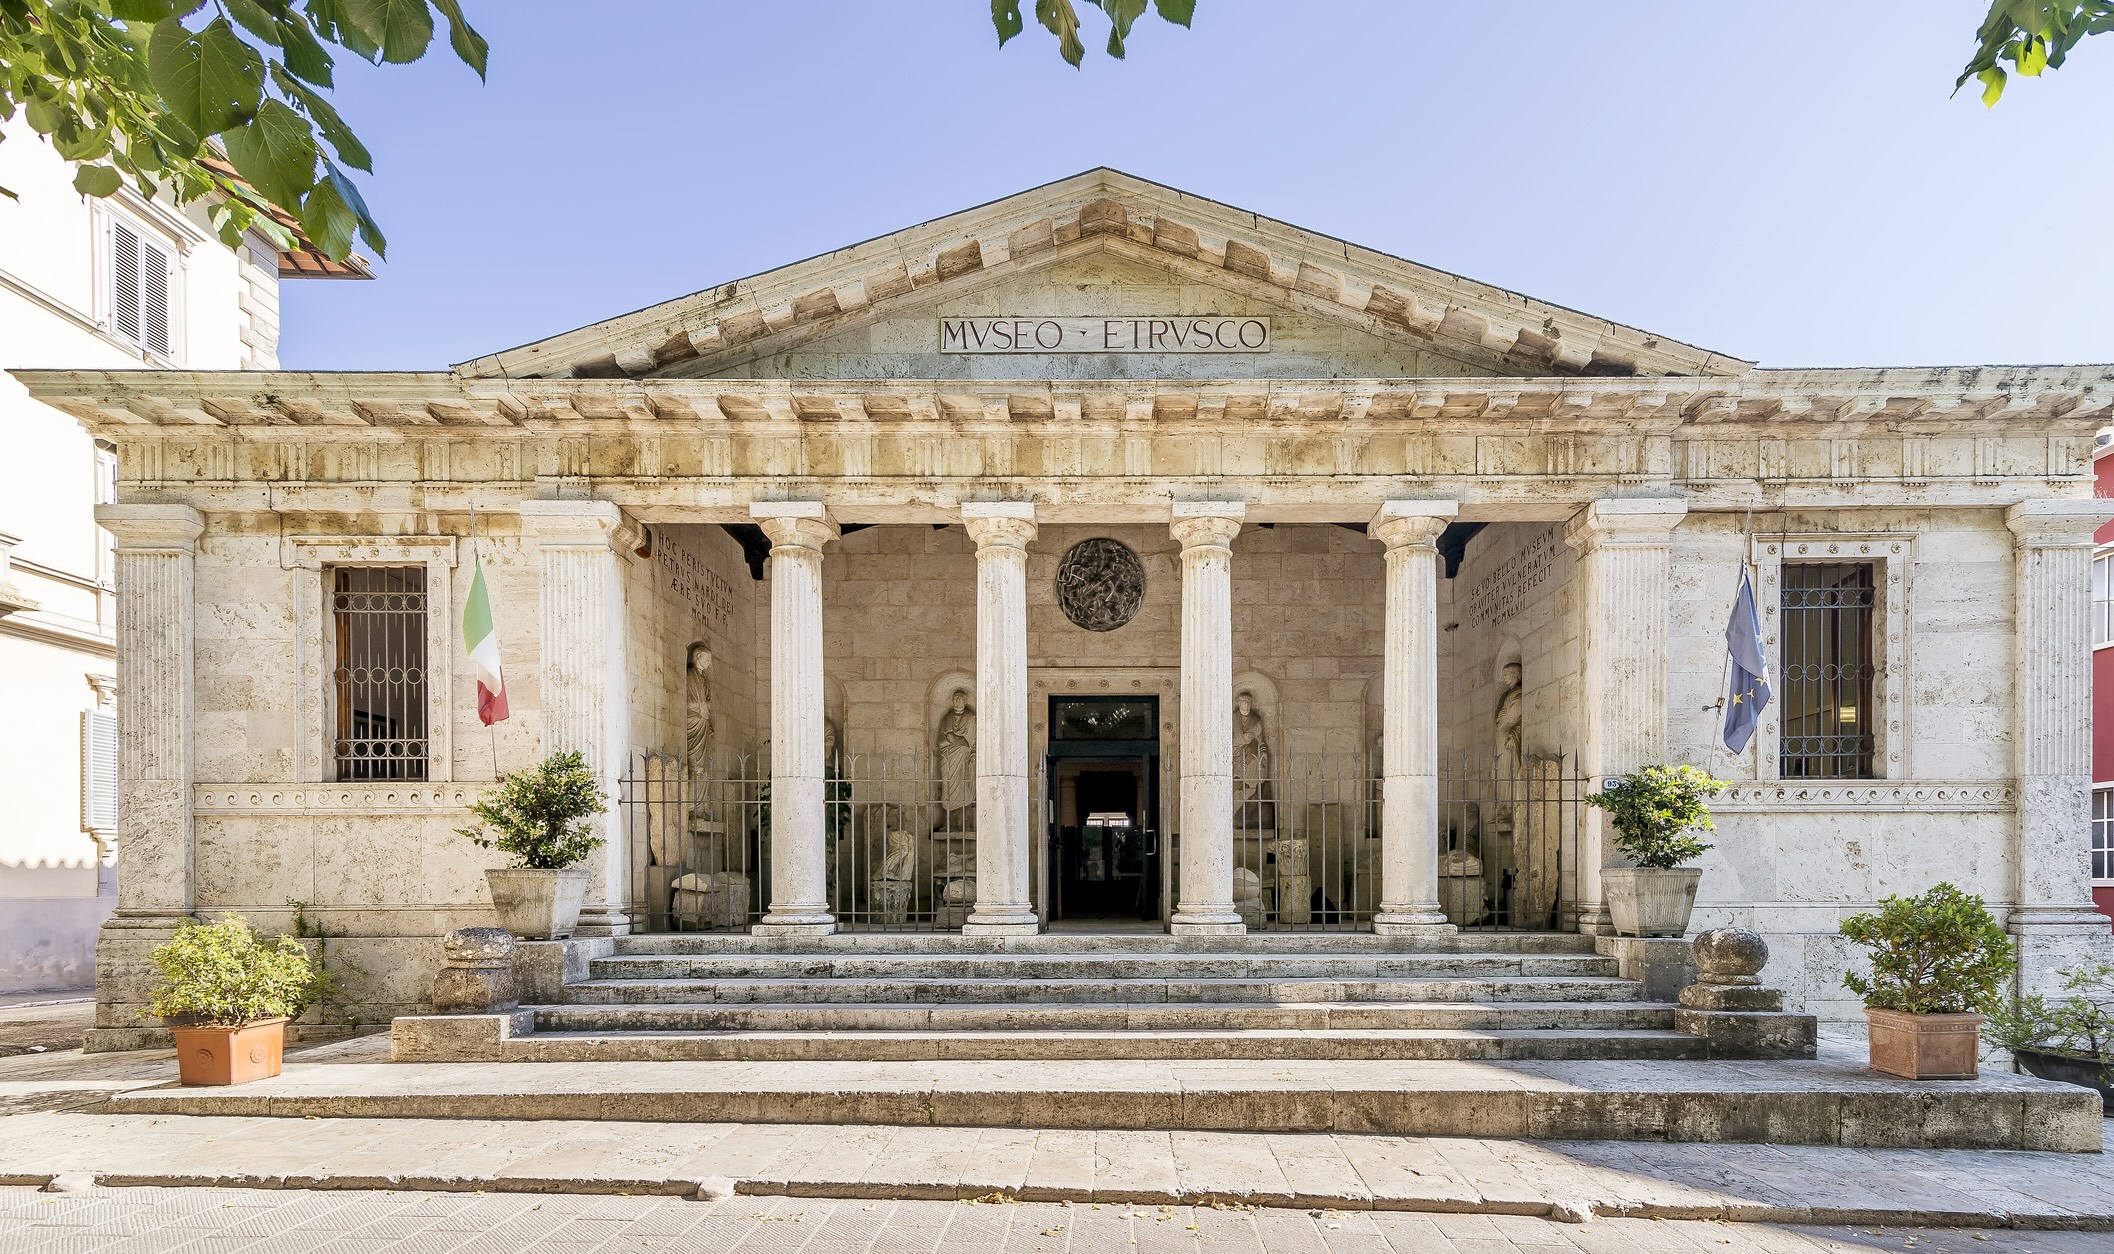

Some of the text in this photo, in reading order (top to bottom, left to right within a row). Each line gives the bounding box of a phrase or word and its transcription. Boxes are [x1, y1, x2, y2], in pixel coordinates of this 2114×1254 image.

[943, 320, 1267, 349] MVSEO ETRVSCO
[657, 549, 691, 583] PETRVS
[659, 531, 734, 598] HOC PERISTYLIVM
[1469, 544, 1556, 617] GRAVITER VVLNERATVM
[1493, 557, 1516, 585] BELLO
[1520, 527, 1554, 563] MVSEVM
[695, 594, 711, 614] SVO
[1471, 563, 1552, 628] COMMVNITAS REFECIT
